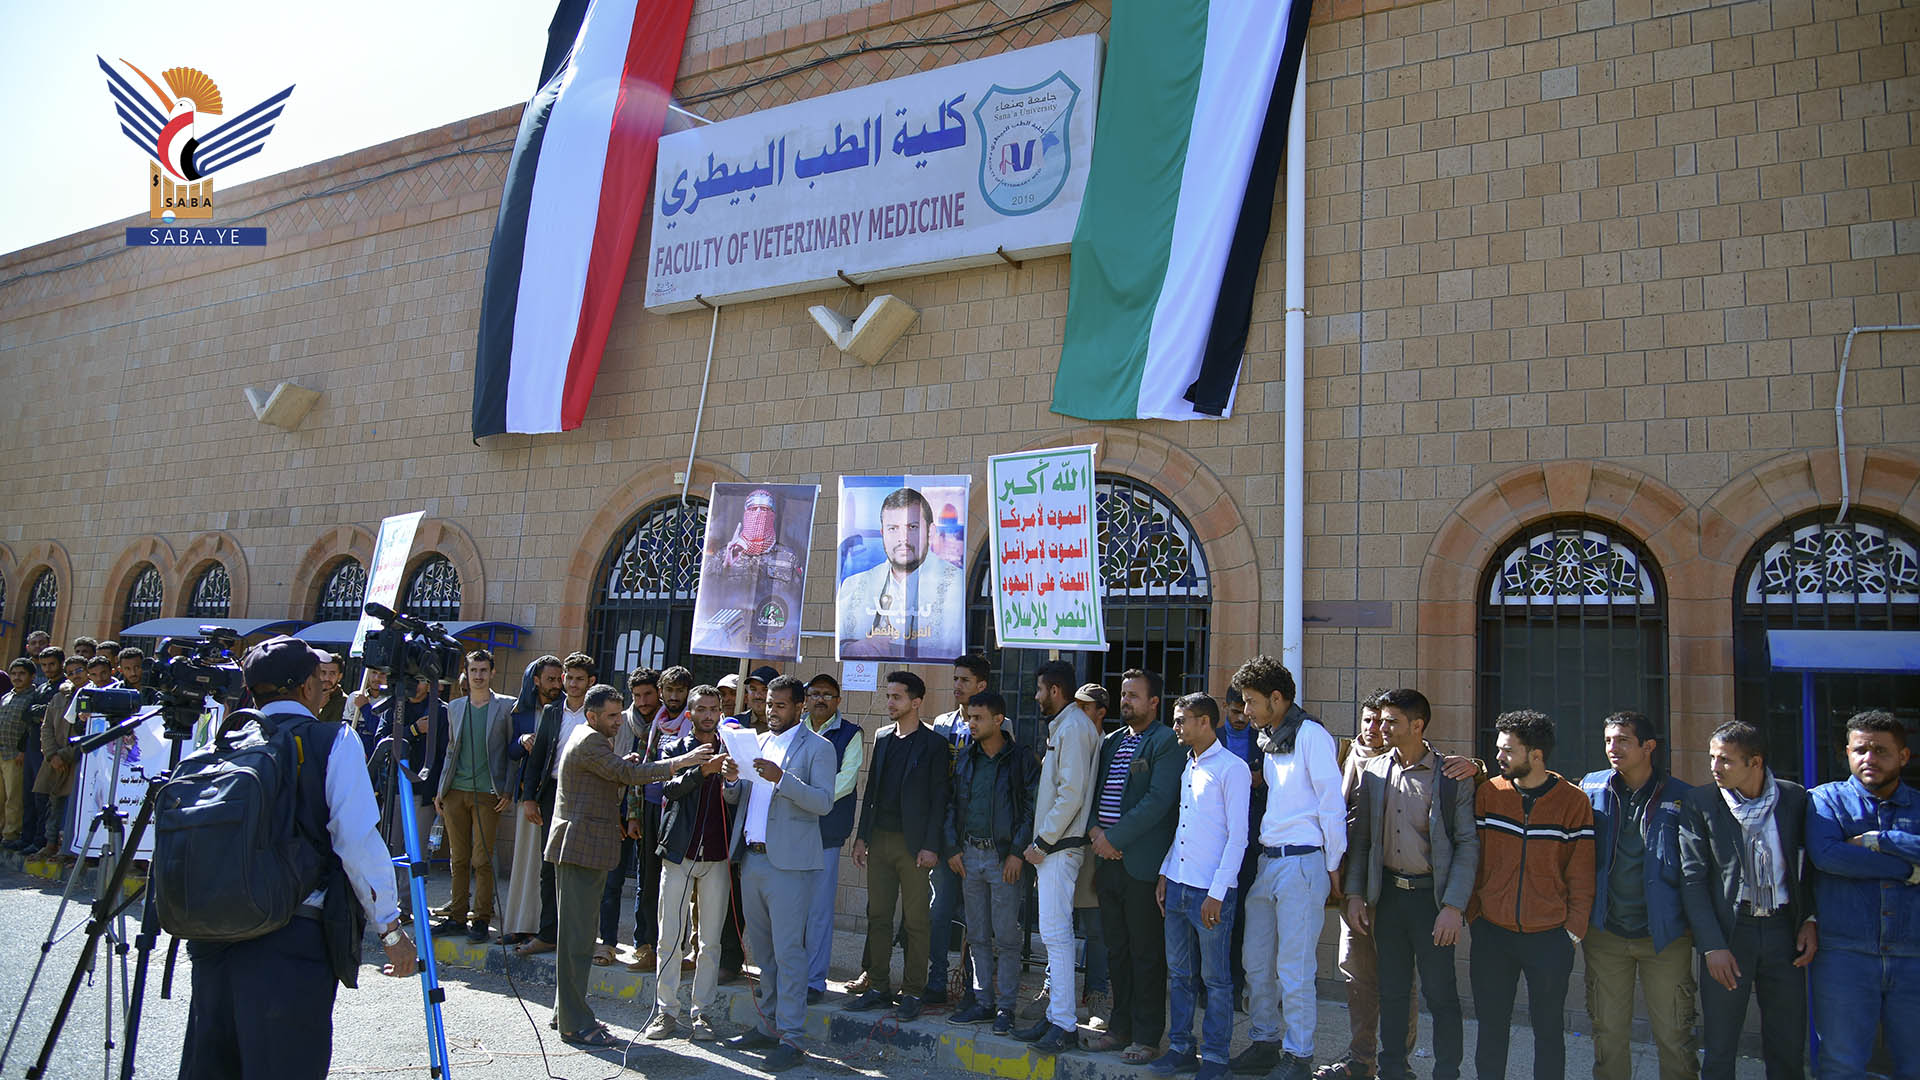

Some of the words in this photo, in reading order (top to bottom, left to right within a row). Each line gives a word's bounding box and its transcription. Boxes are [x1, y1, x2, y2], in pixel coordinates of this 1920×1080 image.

[994, 99, 1024, 113] صنعاء
[1020, 103, 1058, 117] University
[1027, 92, 1057, 105] جامعة
[892, 91, 967, 169] كلية
[794, 113, 882, 190] الطب
[661, 135, 786, 230] البيطري
[1011, 193, 1035, 206] 2019
[654, 235, 724, 278] FACULTY
[726, 230, 750, 266] OF
[753, 210, 864, 261] VETERINARY
[867, 191, 966, 242] MEDICINE
[998, 458, 1050, 506] أكبر
[1051, 460, 1087, 492] الله
[999, 501, 1045, 533] لأمريكا
[1047, 503, 1087, 531] الموت
[1001, 538, 1046, 565] لإسرائيل
[1048, 537, 1088, 564] الموت
[1001, 571, 1034, 597] اليهود
[1036, 571, 1055, 597] على
[1059, 571, 1090, 593] اللعنة
[1004, 600, 1048, 637] للإسلام
[1051, 598, 1093, 636] النصر
